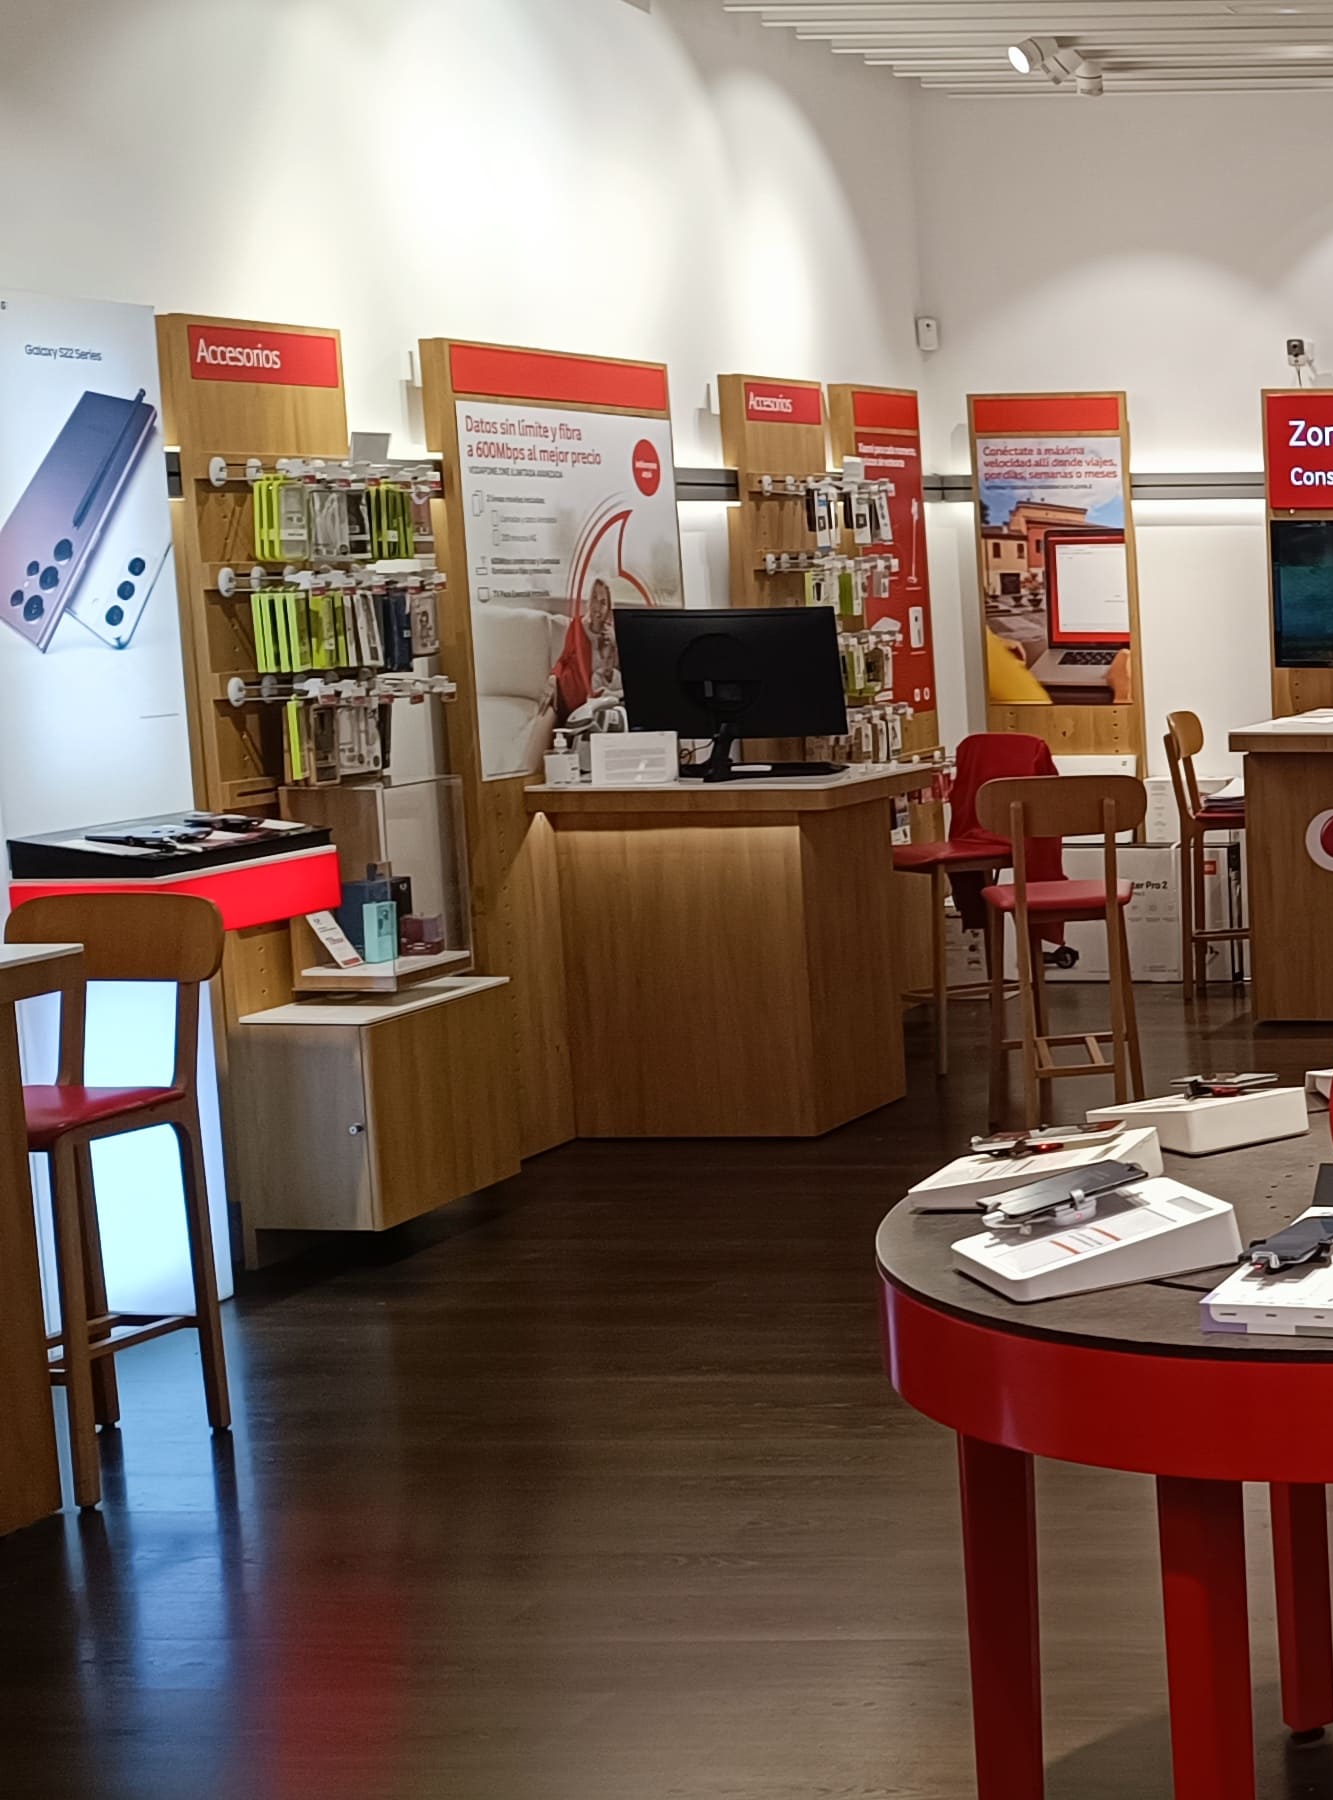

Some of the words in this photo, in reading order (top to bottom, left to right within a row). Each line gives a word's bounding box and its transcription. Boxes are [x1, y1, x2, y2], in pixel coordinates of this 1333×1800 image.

[24, 344, 57, 360] Galaxy
[58, 347, 74, 359] S22
[74, 348, 102, 361] Series
[196, 338, 281, 369] Accesorios
[748, 392, 793, 413] Accesorios
[465, 415, 498, 434] Datos
[500, 418, 516, 435] sin
[518, 418, 549, 438] límite
[551, 426, 557, 443] y
[559, 423, 582, 441] fibra
[467, 444, 474, 457] a
[475, 441, 525, 464] 600Mbps
[527, 445, 537, 461] al
[539, 447, 569, 467] mejor
[571, 449, 602, 468] precio
[983, 446, 1033, 456] Conéctate
[1036, 447, 1042, 455] a
[1044, 445, 1085, 455] máxima
[983, 458, 1032, 468] velocidad
[1034, 457, 1049, 467] allí
[1051, 458, 1083, 467] donde
[984, 471, 1001, 481] por
[1028, 471, 1074, 479] semanas
[1084, 470, 1117, 478] meses
[1146, 881, 1161, 889] Pro
[1162, 881, 1168, 889] 2
